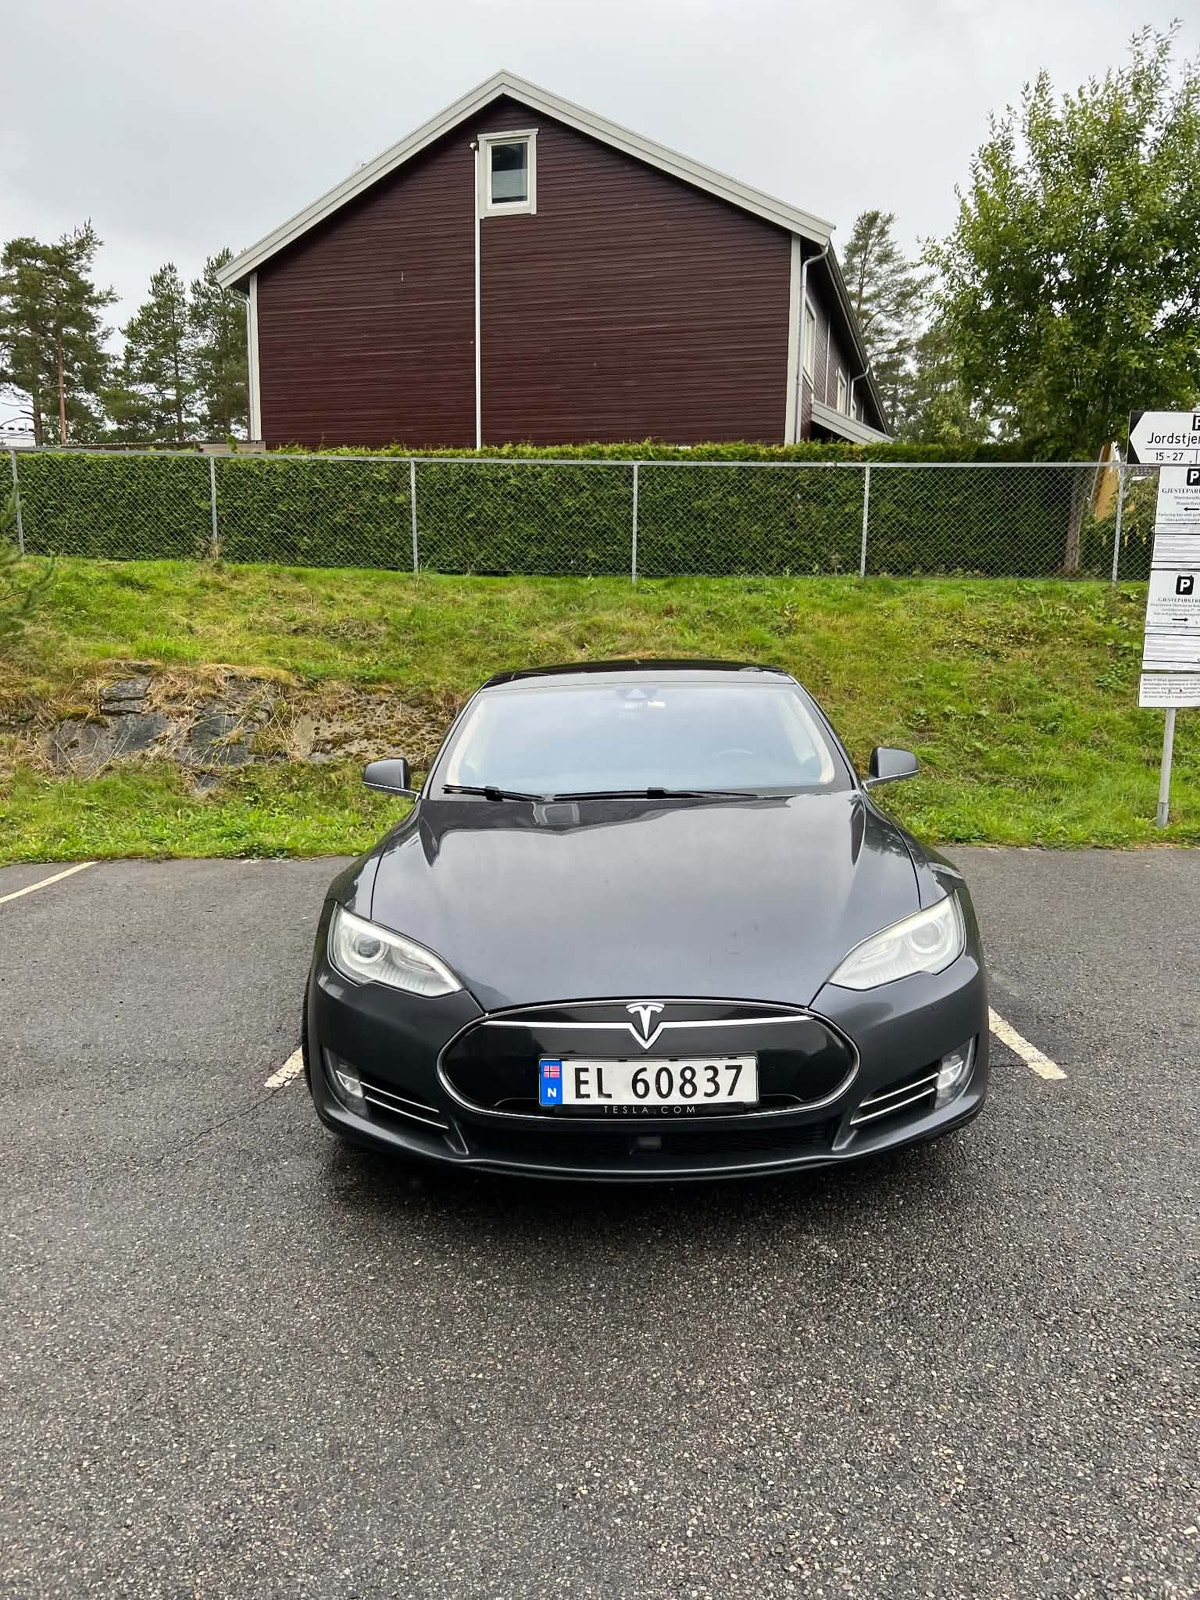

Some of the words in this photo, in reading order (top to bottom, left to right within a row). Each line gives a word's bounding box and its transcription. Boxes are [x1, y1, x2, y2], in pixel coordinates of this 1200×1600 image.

[1155, 452, 1164, 461] 15
[1172, 452, 1184, 461] 27
[1179, 578, 1191, 592] P
[574, 1067, 613, 1099] EL
[631, 1064, 743, 1099] 60837
[547, 1088, 557, 1098] N
[603, 1105, 697, 1114] TESLA.COM
